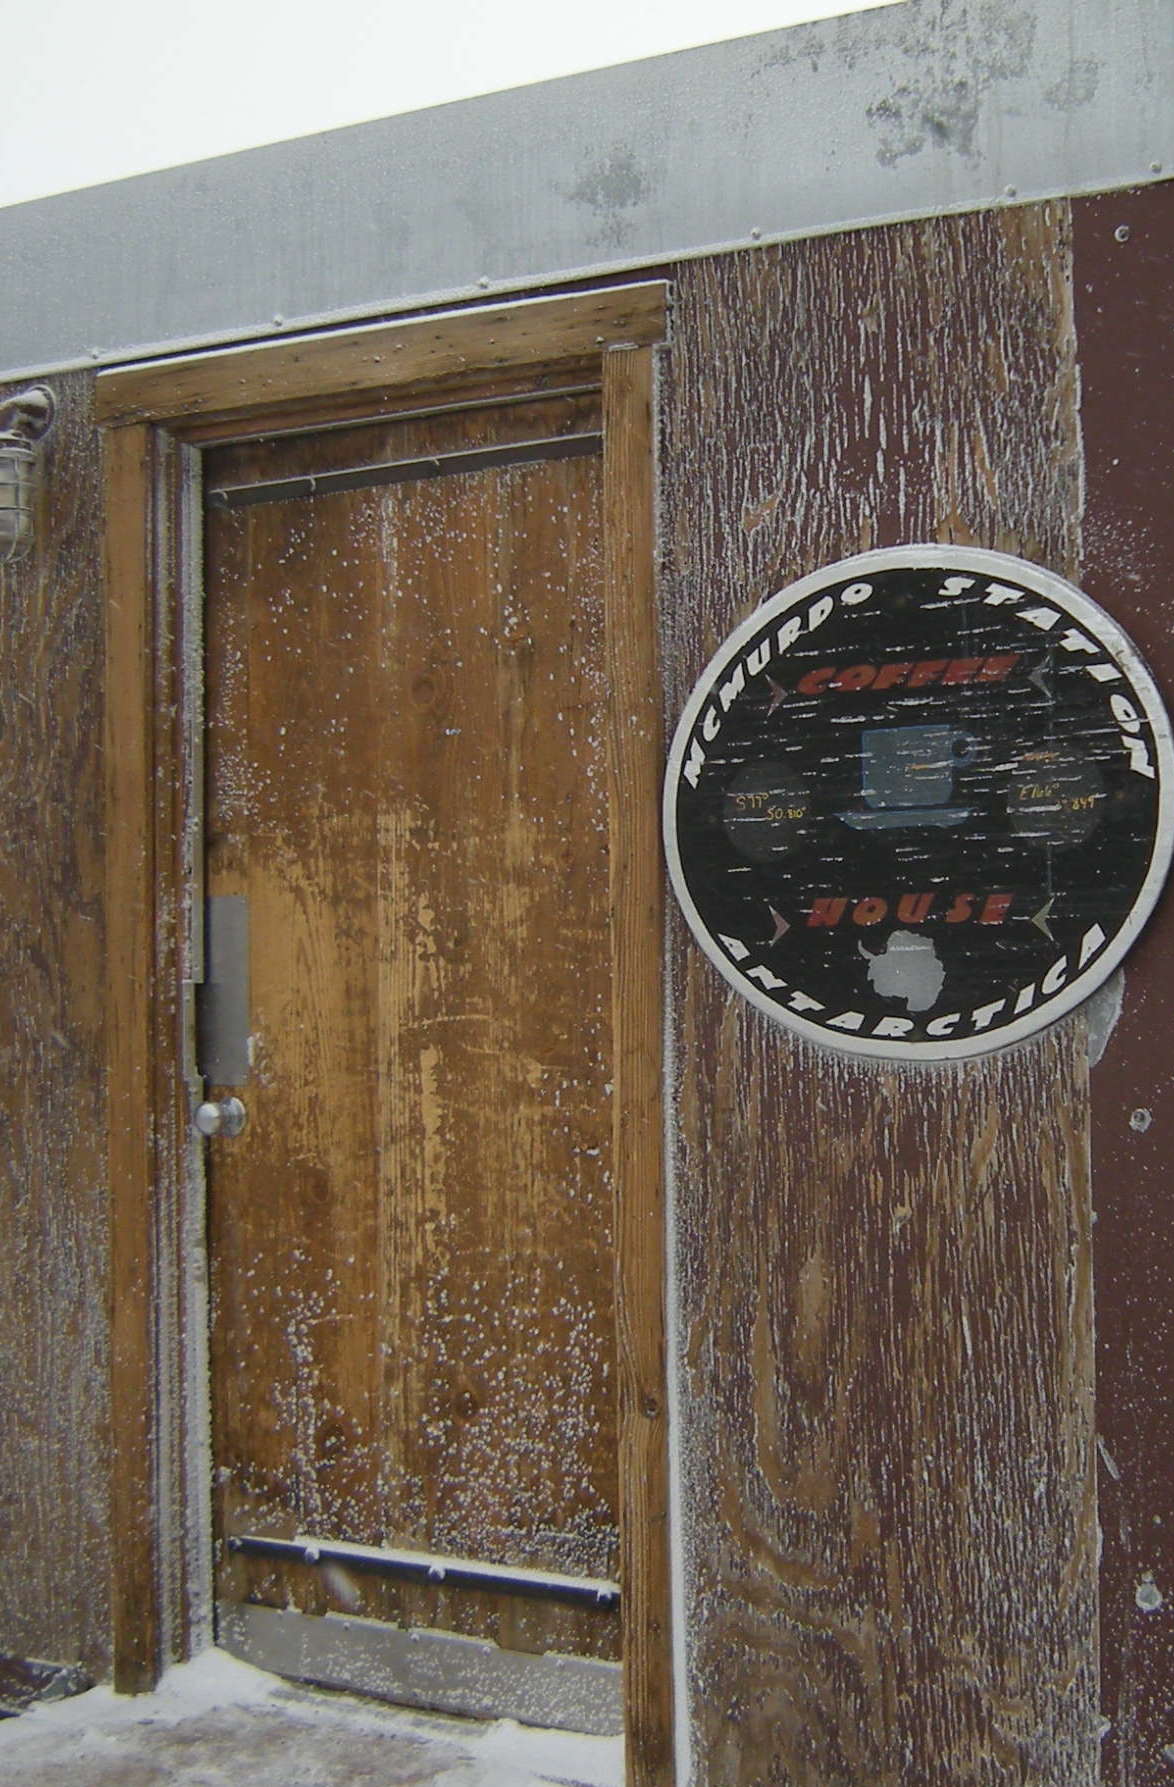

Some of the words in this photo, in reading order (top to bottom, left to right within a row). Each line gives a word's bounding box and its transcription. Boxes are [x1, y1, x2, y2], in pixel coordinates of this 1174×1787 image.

[683, 582, 873, 789] MCMURDO
[938, 576, 1155, 779] STATION
[796, 654, 1020, 695] COFFEE
[807, 893, 1015, 928] HOUSE
[718, 923, 1107, 1039] ANTARCTICA
